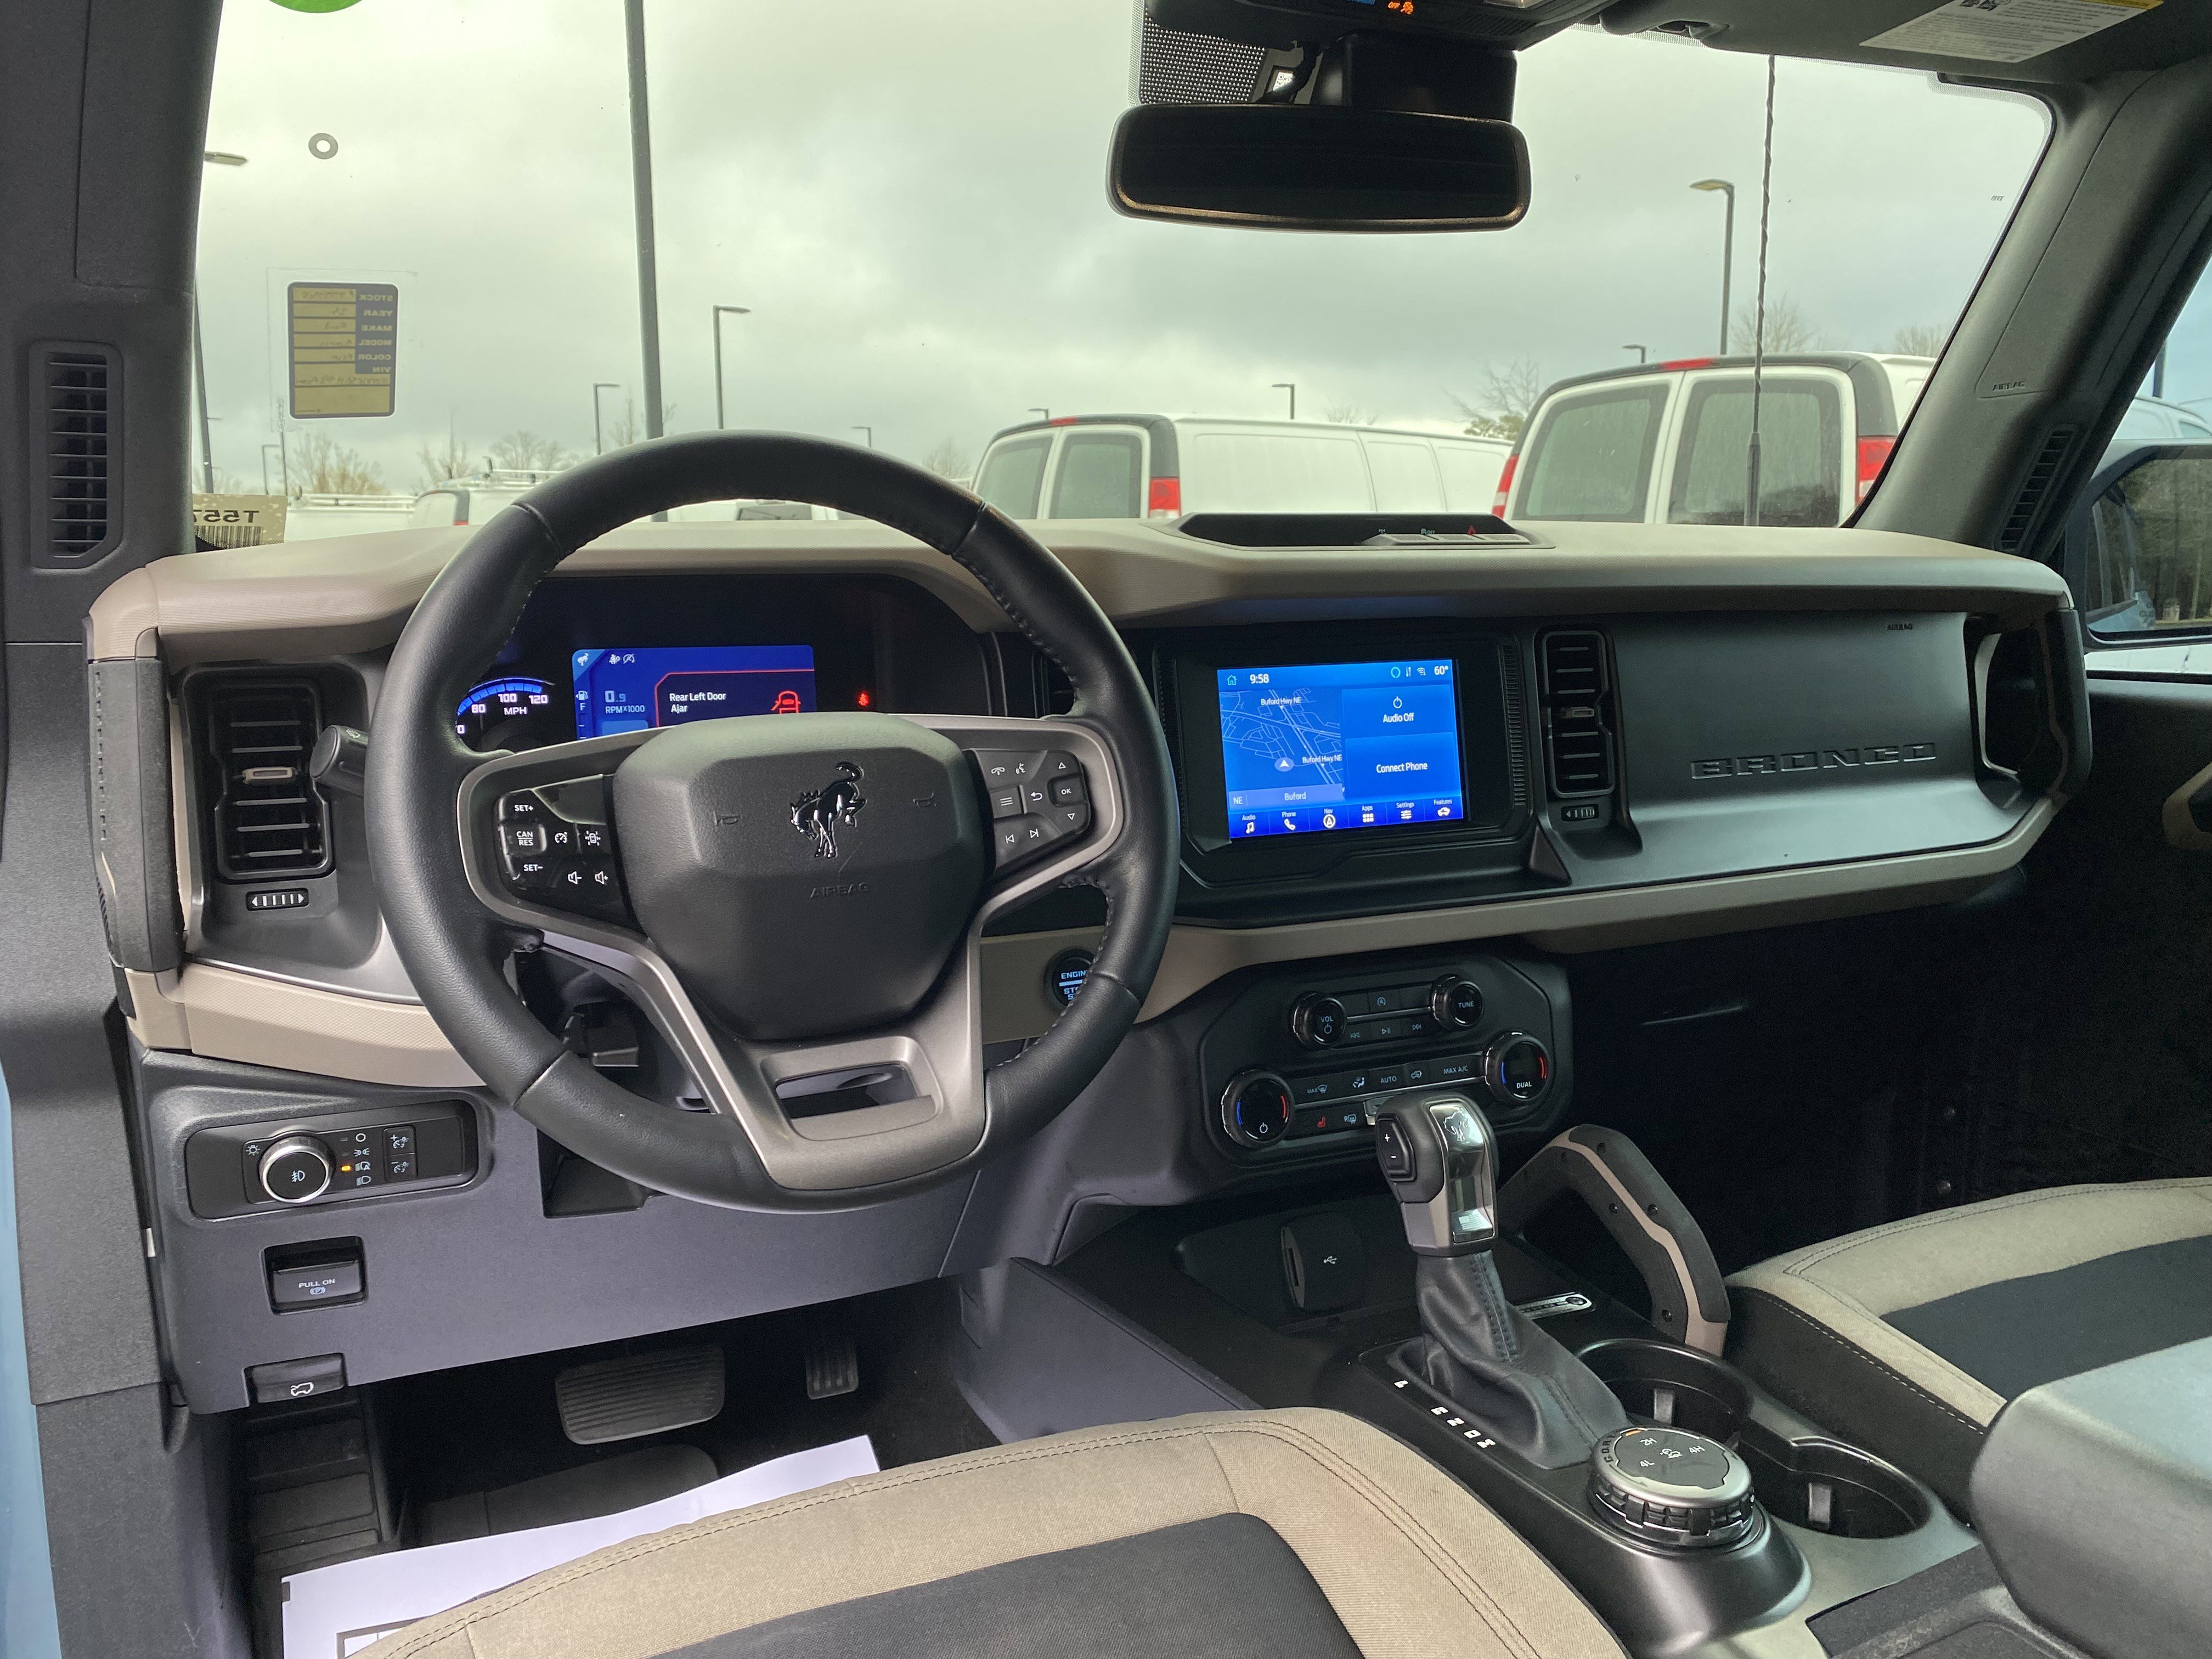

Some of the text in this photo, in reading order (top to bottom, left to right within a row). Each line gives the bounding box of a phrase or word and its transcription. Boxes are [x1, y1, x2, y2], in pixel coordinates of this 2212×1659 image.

[1387, 1, 1400, 9] OFF
[1993, 381, 2025, 391] AIRBAG
[1249, 673, 1269, 684] 9:58
[498, 693, 517, 703] 100
[529, 695, 548, 704] 120
[669, 691, 726, 702] Rear Left Door
[1280, 697, 1293, 706] Hwy
[471, 704, 486, 713] 80
[504, 707, 527, 715] MPH
[670, 704, 687, 714] Ajar
[1383, 712, 1414, 723] Audio Off
[1321, 755, 1334, 763] Hwy
[1691, 742, 1937, 780] BRONCO
[1376, 762, 1428, 773] Connect Phone
[1233, 797, 1243, 805] NE
[1284, 792, 1307, 801] Buford
[810, 882, 869, 898] AIRBAG
[1060, 970, 1086, 979] ENGIN
[1443, 1066, 1457, 1075] MAX
[1380, 1075, 1397, 1084] AUTO
[1394, 1380, 1408, 1389] P
[1447, 1417, 1464, 1426] N
[1463, 1429, 1481, 1438] D
[1476, 1438, 1496, 1448] M
[1640, 1437, 1657, 1446] 2H
[1689, 1445, 1705, 1454] 4H
